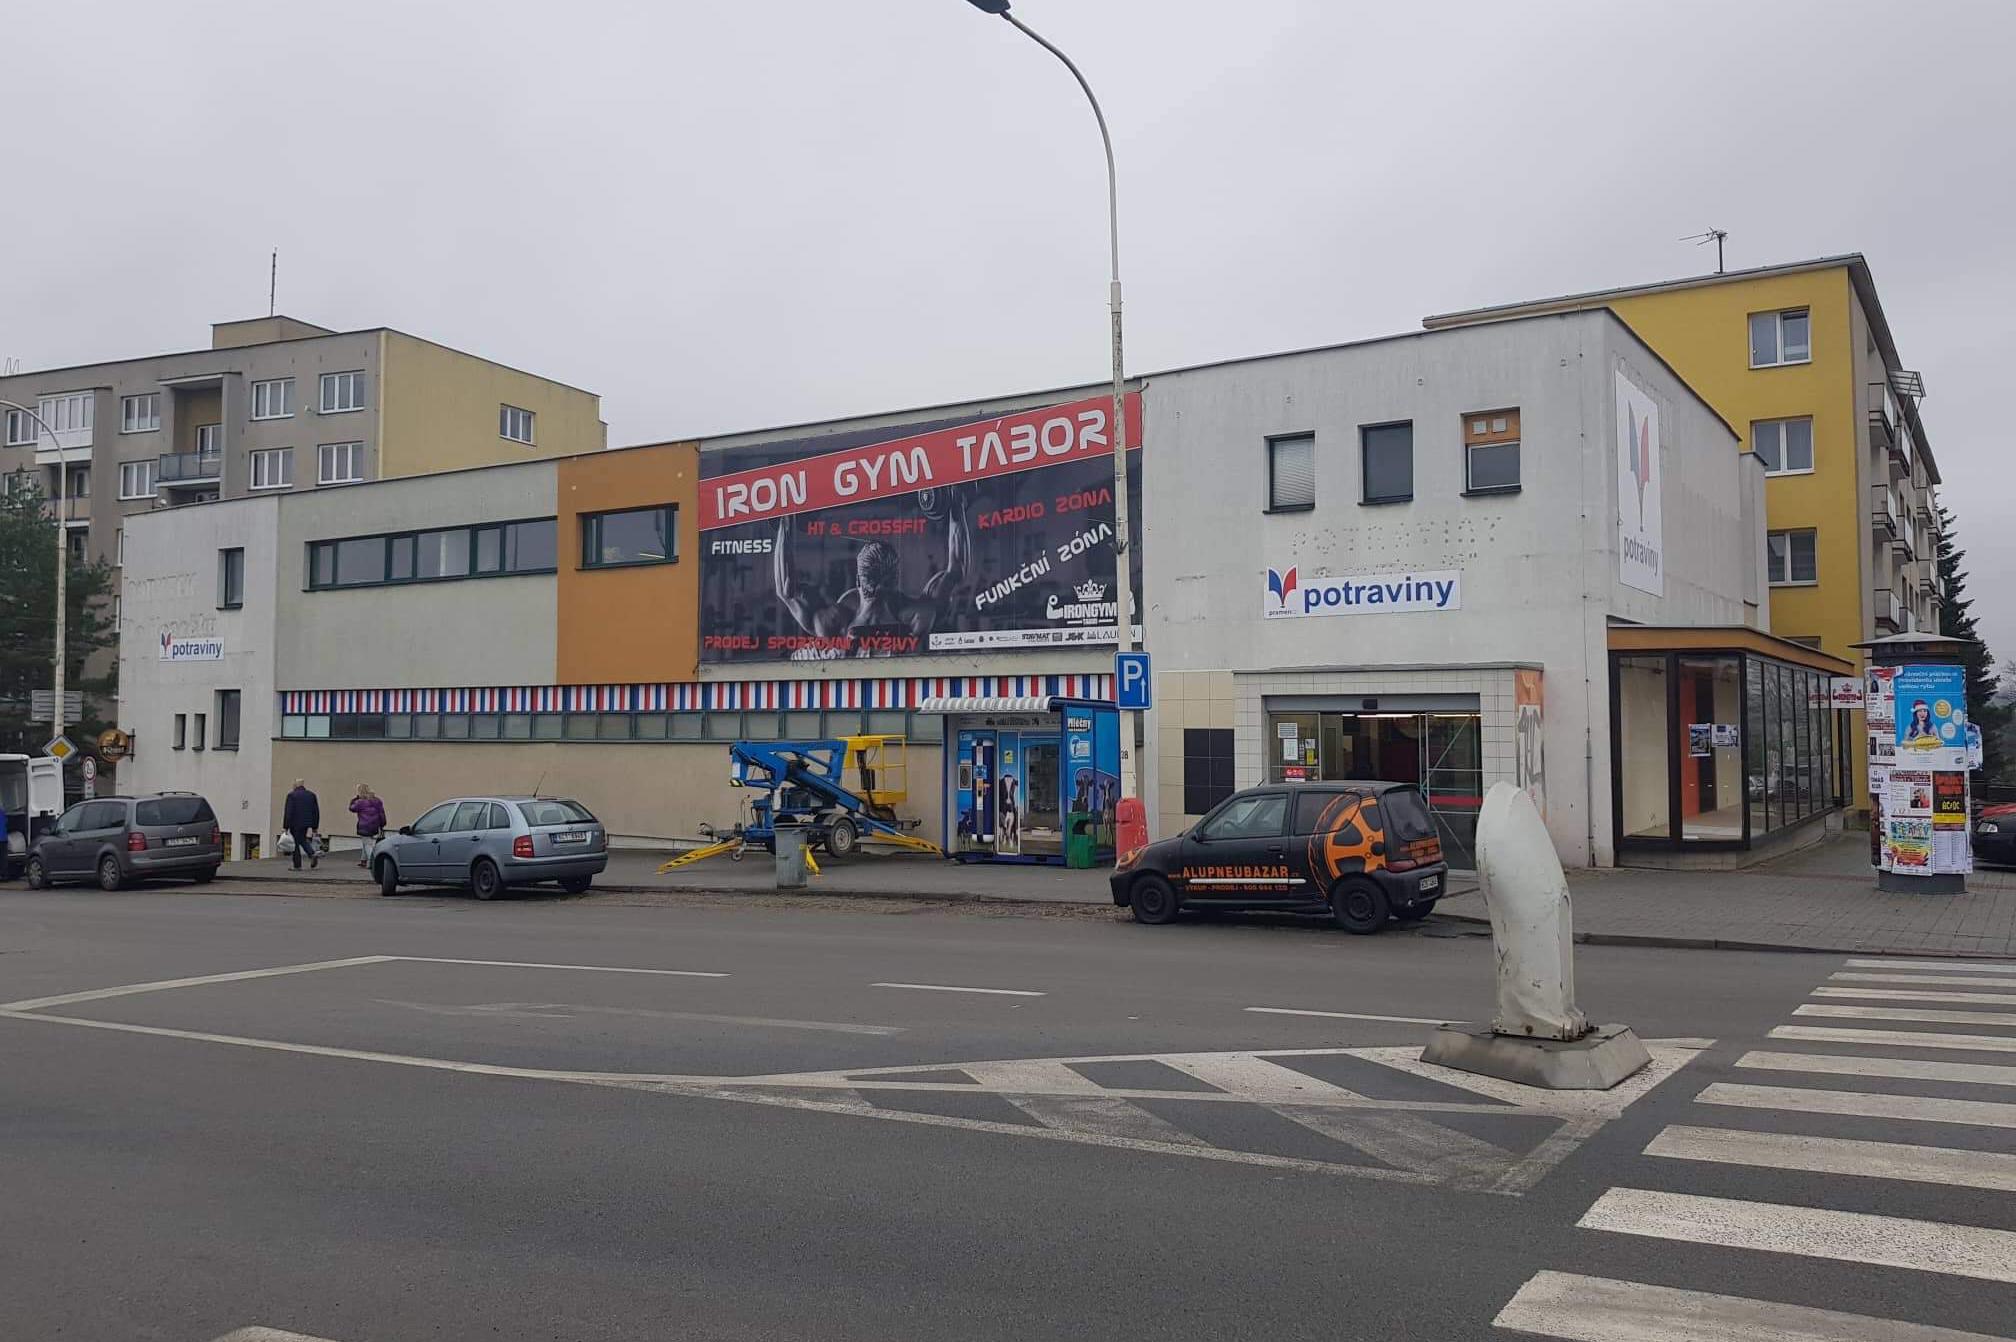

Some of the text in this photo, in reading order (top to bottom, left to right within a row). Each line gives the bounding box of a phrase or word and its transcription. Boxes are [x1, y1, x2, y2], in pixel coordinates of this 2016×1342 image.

[716, 408, 1108, 520] IRON GYM TÁBOR
[978, 488, 1112, 530] KARDIO ZÓNA
[807, 520, 827, 537] HT
[847, 517, 929, 537] CROSSFIT
[711, 539, 772, 555] FITNESS
[1623, 534, 1659, 577] potraviny
[975, 522, 1113, 611] FUNKČNÍ ZÓNA
[1304, 576, 1454, 614] potraviny
[172, 639, 223, 659] potraviny
[704, 635, 760, 650] PRODEJ
[1123, 659, 1143, 692] P
[1182, 865, 1289, 879] ALUPNEUBAZAR
